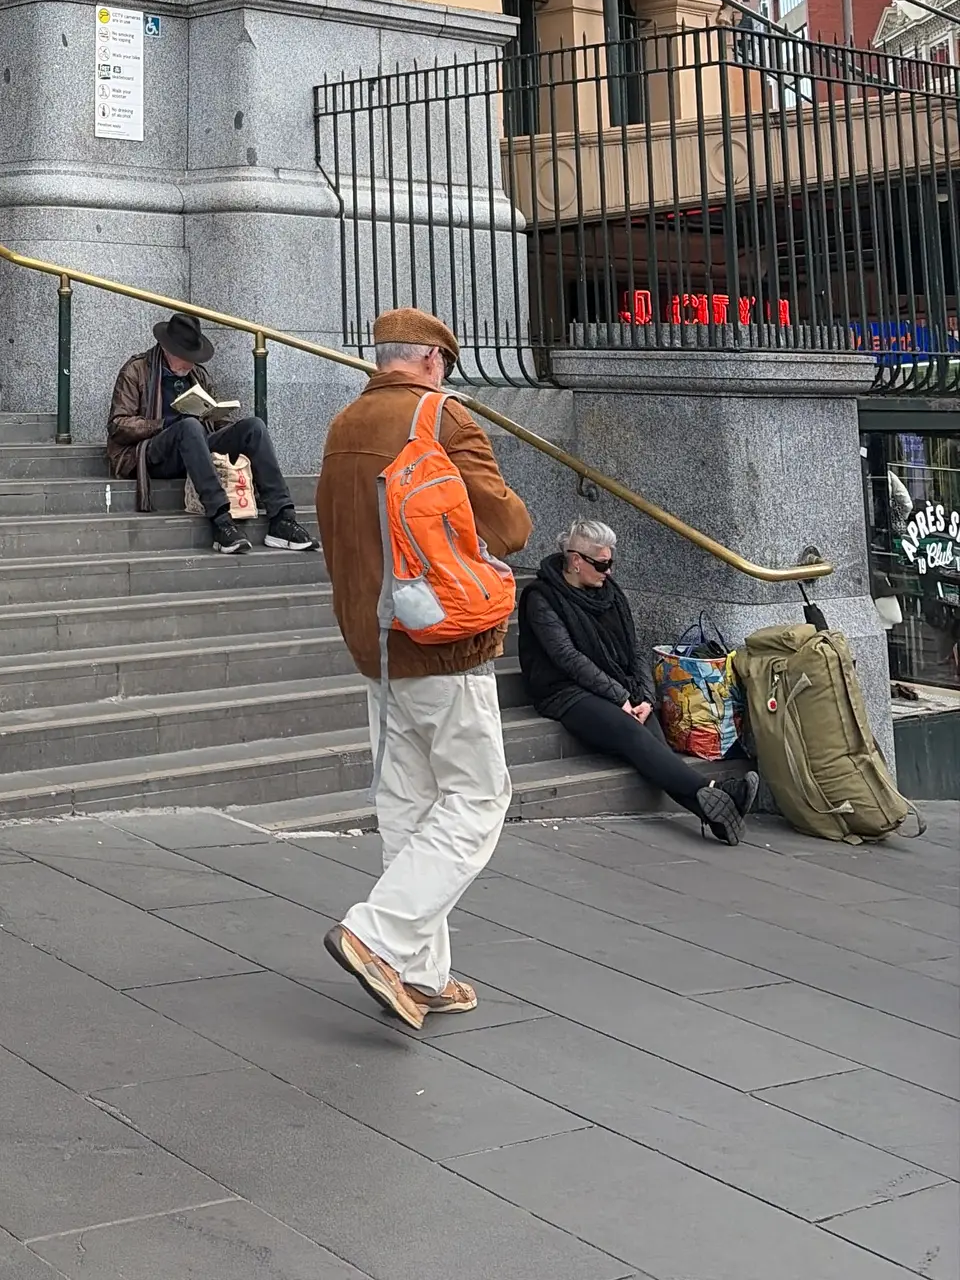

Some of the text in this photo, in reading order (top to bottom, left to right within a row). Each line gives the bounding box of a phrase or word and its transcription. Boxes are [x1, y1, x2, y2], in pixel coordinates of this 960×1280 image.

[902, 501, 960, 562] APRÈS S
[926, 541, 954, 568] Club
